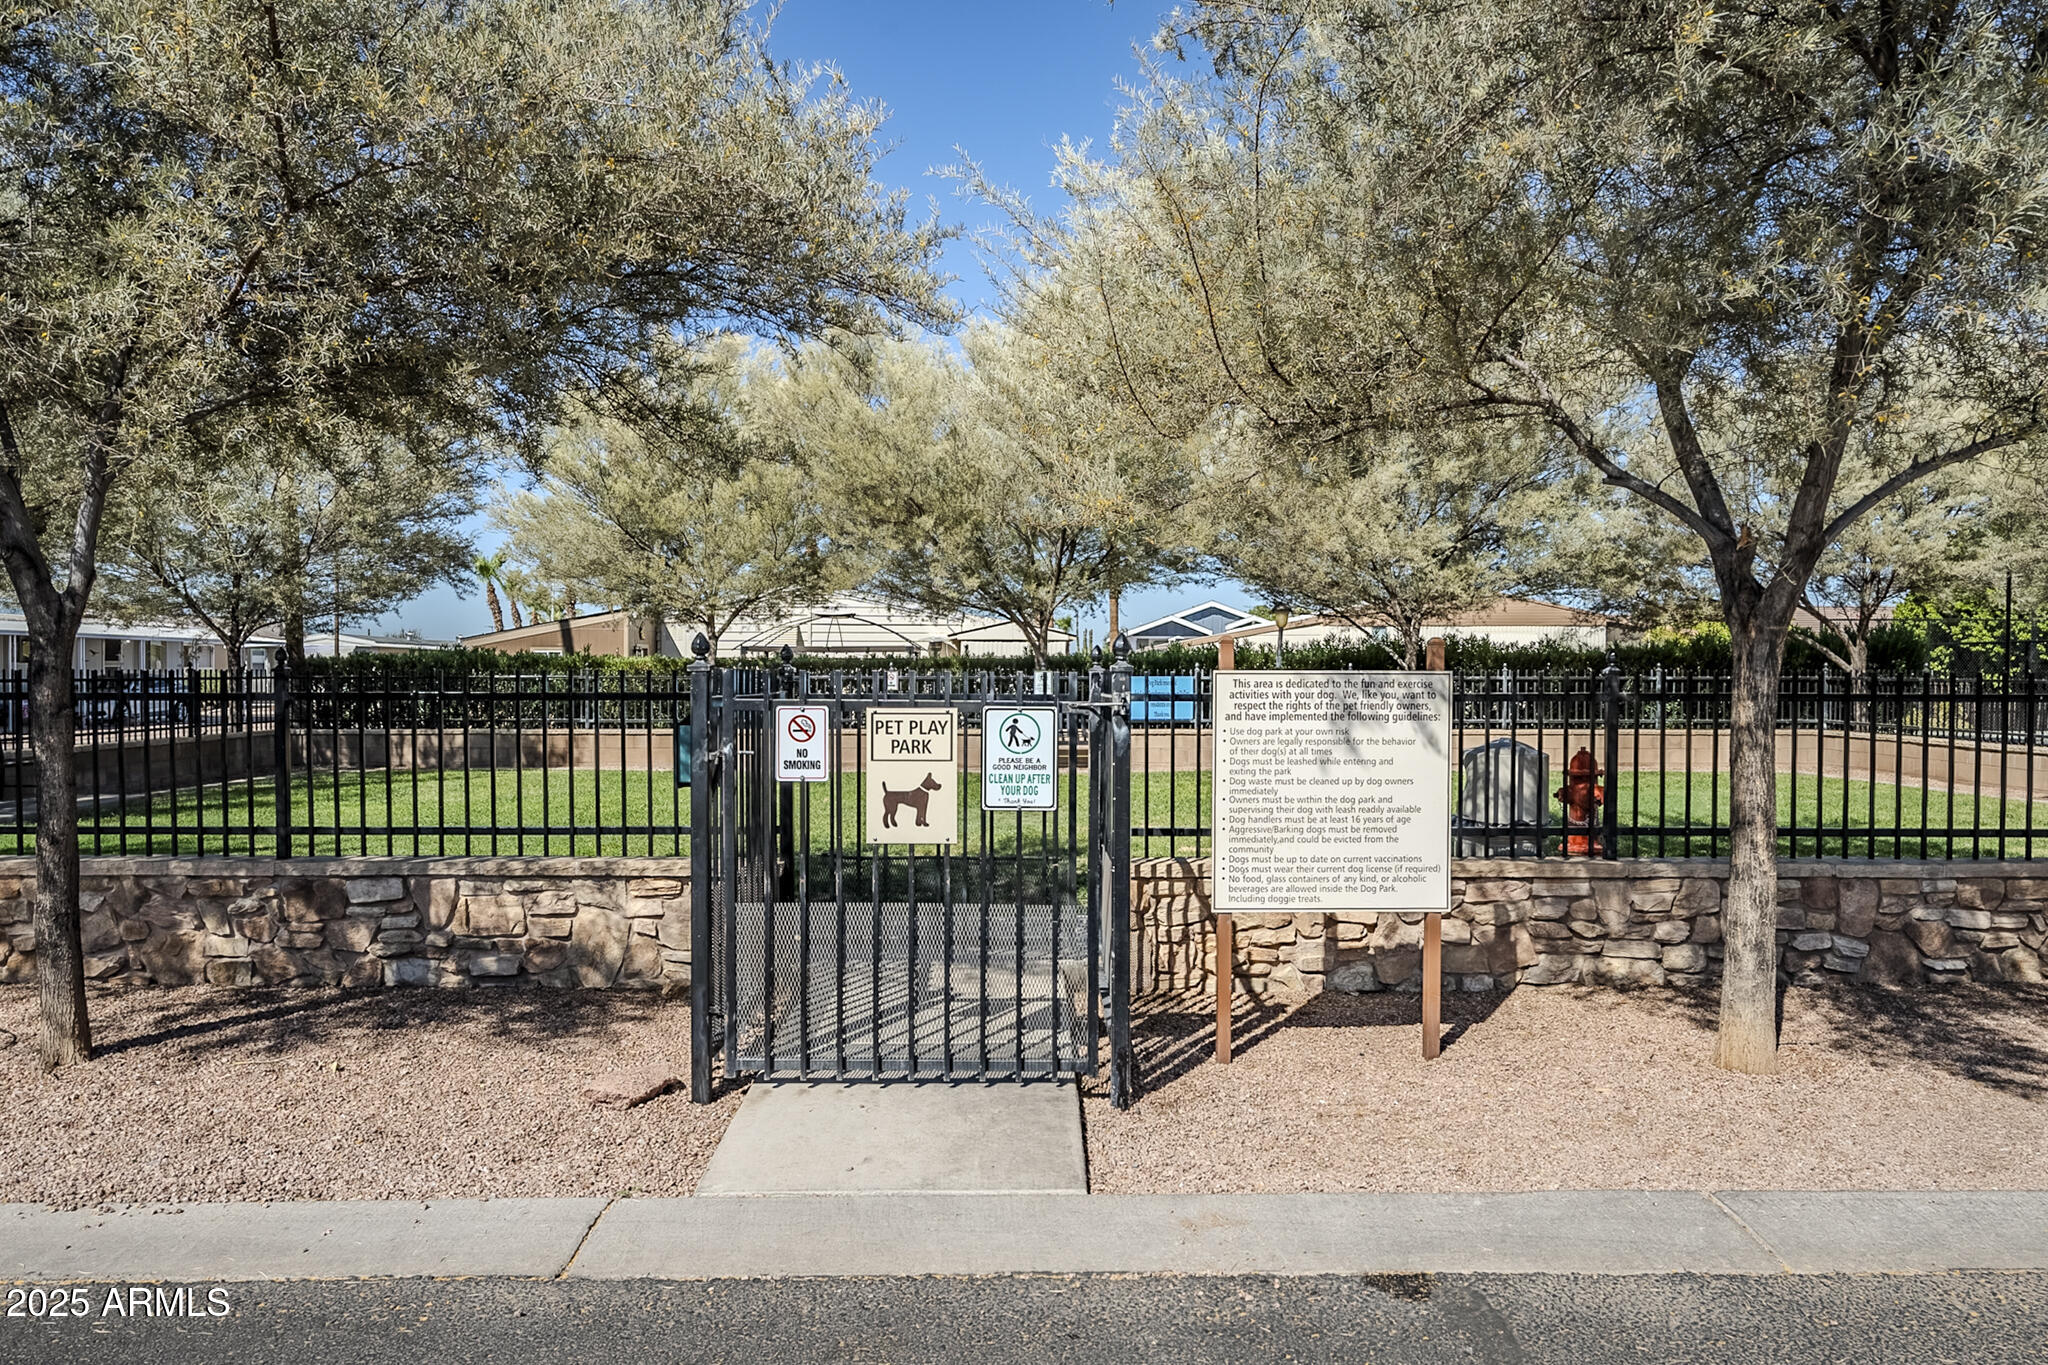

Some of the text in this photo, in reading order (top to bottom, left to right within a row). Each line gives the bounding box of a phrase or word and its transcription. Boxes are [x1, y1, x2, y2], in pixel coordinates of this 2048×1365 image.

[1233, 678, 1251, 688] This
[1275, 678, 1283, 688] is
[1285, 678, 1330, 688] dedicated
[1332, 678, 1342, 688] to
[1344, 678, 1359, 688] the
[1361, 678, 1376, 688] fun
[1378, 678, 1395, 688] and
[1397, 678, 1433, 688] exercise
[1229, 689, 1436, 702] activities with your dog. We, like you, want to
[1234, 700, 1432, 713] respect the rights of the pet friendly owners,
[1224, 711, 1441, 723] and have implemented the following guidelines:
[876, 720, 948, 735] PET PLAY
[1229, 727, 1244, 735] Use
[1247, 727, 1263, 737] dog
[1265, 727, 1283, 737] park
[1335, 727, 1350, 735] risk
[892, 740, 932, 754] PARK
[1229, 737, 1261, 745] Owners
[1277, 737, 1303, 747] legally
[1305, 737, 1351, 747] responsible
[1352, 737, 1364, 745] for
[1366, 737, 1380, 745] the
[1381, 737, 1416, 745] behavior
[796, 748, 808, 758] NO
[784, 760, 821, 770] SMOKING
[1229, 757, 1394, 767] Dogs must be leashed while entering and
[1229, 767, 1292, 777] exiting the park
[989, 773, 1050, 784] CLEAN UP AFTER
[1229, 777, 1246, 787] Dog
[1248, 777, 1272, 785] waste
[1274, 777, 1295, 785] must
[1296, 777, 1307, 785] be
[1308, 777, 1340, 785] cleaned
[1354, 777, 1365, 787] by
[1366, 777, 1383, 787] dog
[1000, 785, 1039, 795] YOUR DOG
[1229, 786, 1279, 796] immediately
[1228, 795, 1393, 805] Owners must be within the dog park and
[1228, 805, 1422, 815] supervising their dog with leash readily available
[1229, 815, 1246, 825] Dog
[1248, 815, 1282, 823] handlers
[1284, 815, 1305, 823] must
[1307, 815, 1318, 823] be
[1329, 815, 1349, 823] least
[1351, 815, 1361, 823] 16
[1385, 815, 1394, 823] of
[1306, 825, 1327, 835] dogs
[1328, 825, 1349, 833] must
[1350, 825, 1361, 833] be
[1362, 825, 1398, 833] removed
[1228, 845, 1274, 855] community
[1228, 855, 1250, 865] Dogs
[1251, 855, 1272, 863] must
[1274, 855, 1285, 863] be
[1299, 855, 1308, 863] to
[1310, 855, 1329, 863] date
[1342, 855, 1372, 863] current
[1373, 855, 1423, 863] vaccinations
[1228, 865, 1249, 875] Dogs
[1251, 865, 1272, 873] must
[1296, 865, 1315, 873] their
[1316, 865, 1346, 873] current
[1347, 865, 1364, 875] dog
[1365, 865, 1393, 873] license
[1394, 865, 1403, 875] (if
[1404, 865, 1441, 875] required)
[1228, 875, 1241, 883] No
[1242, 875, 1264, 885] food,
[1266, 875, 1287, 885] glass
[1288, 875, 1330, 883] containers
[1331, 875, 1340, 883] of
[1359, 875, 1379, 885] kind,
[1391, 875, 1427, 883] alcoholic
[1228, 885, 1269, 895] beverages
[1285, 885, 1317, 893] allowed
[1319, 885, 1343, 893] inside
[1344, 885, 1359, 893] the
[1360, 885, 1377, 895] Dog
[1379, 885, 1398, 893] Park.
